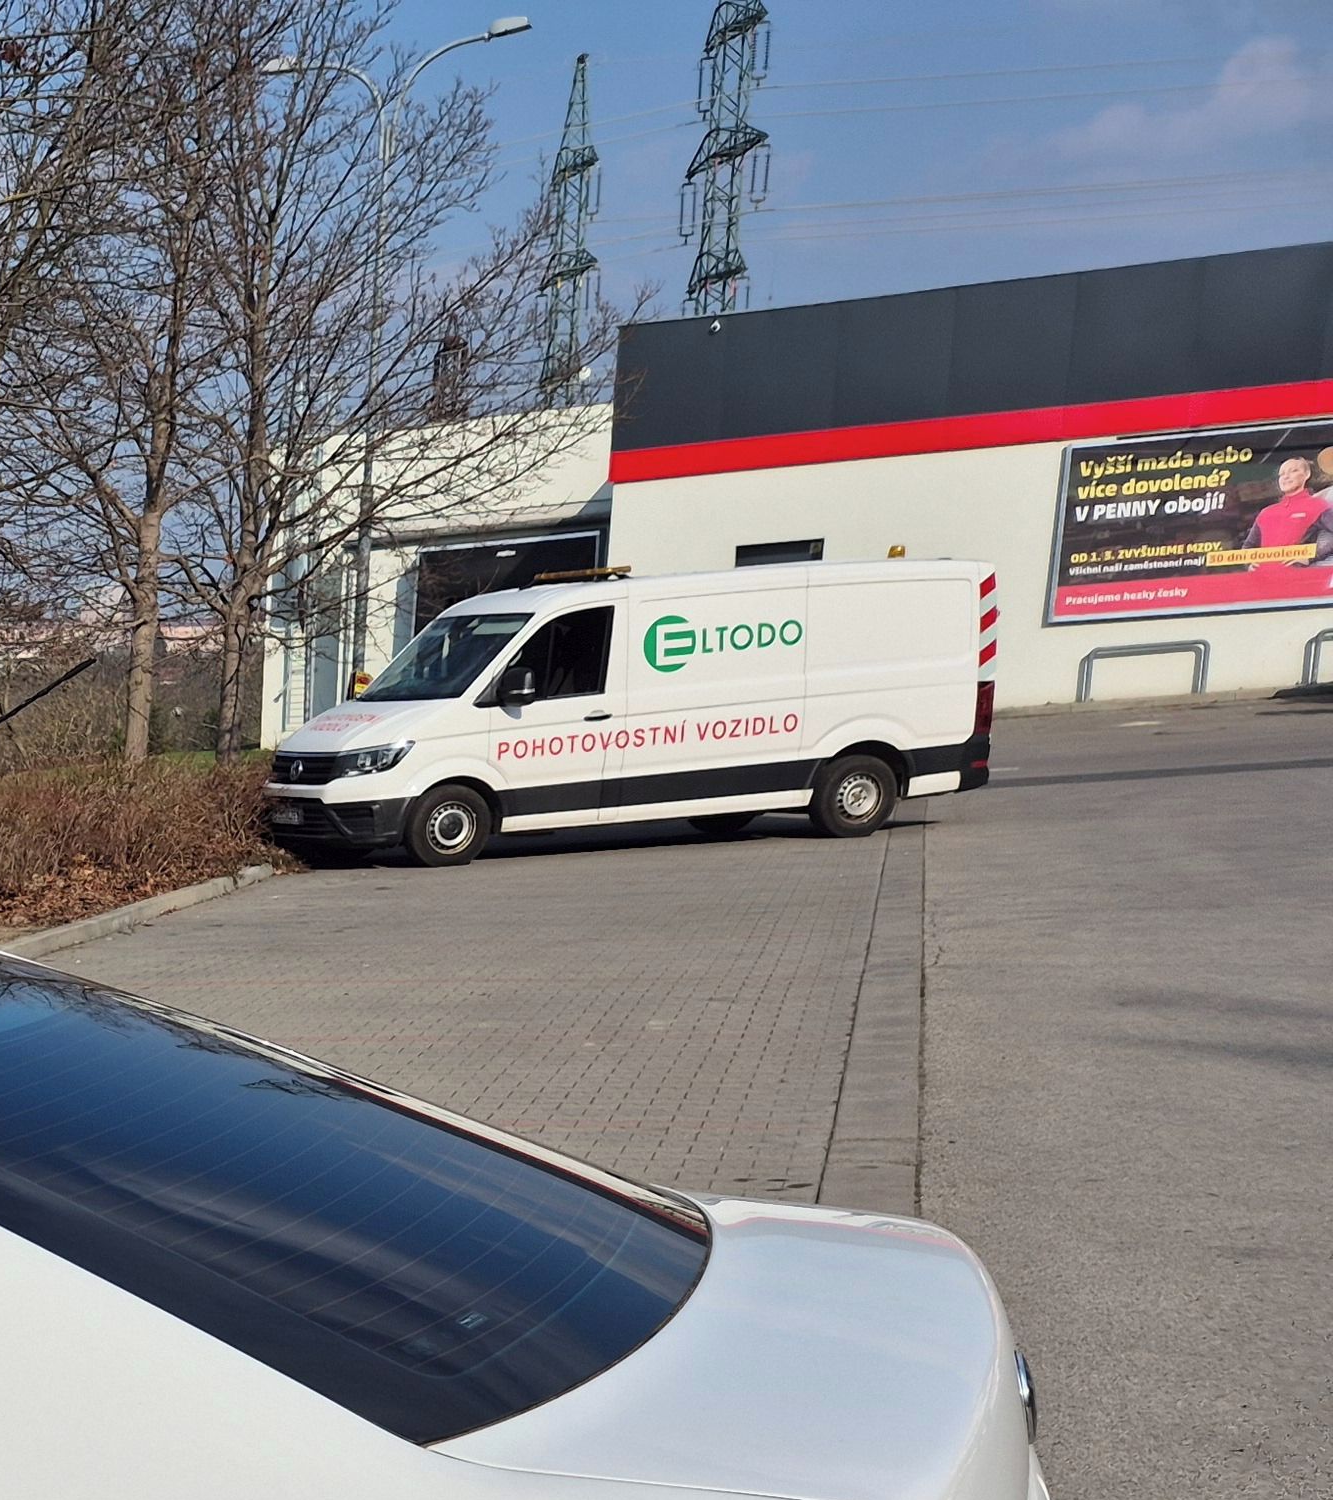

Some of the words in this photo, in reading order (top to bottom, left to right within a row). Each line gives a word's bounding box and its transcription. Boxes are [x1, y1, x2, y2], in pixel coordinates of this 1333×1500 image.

[1079, 454, 1134, 479] Vyšší
[1137, 450, 1194, 472] mzda
[1199, 446, 1253, 466] nebo
[1077, 480, 1118, 500] více
[1122, 469, 1231, 496] dovolené?
[1075, 504, 1090, 522] V
[1093, 499, 1161, 520] PENNY
[1164, 491, 1226, 515] obojí!
[1070, 552, 1088, 563] OD
[1117, 544, 1185, 559] ZVYŠUJEME
[1186, 541, 1223, 555] MZDY.
[496, 719, 688, 761] POHOTOVOSTNÍ
[696, 713, 800, 742] VOZIDLO
